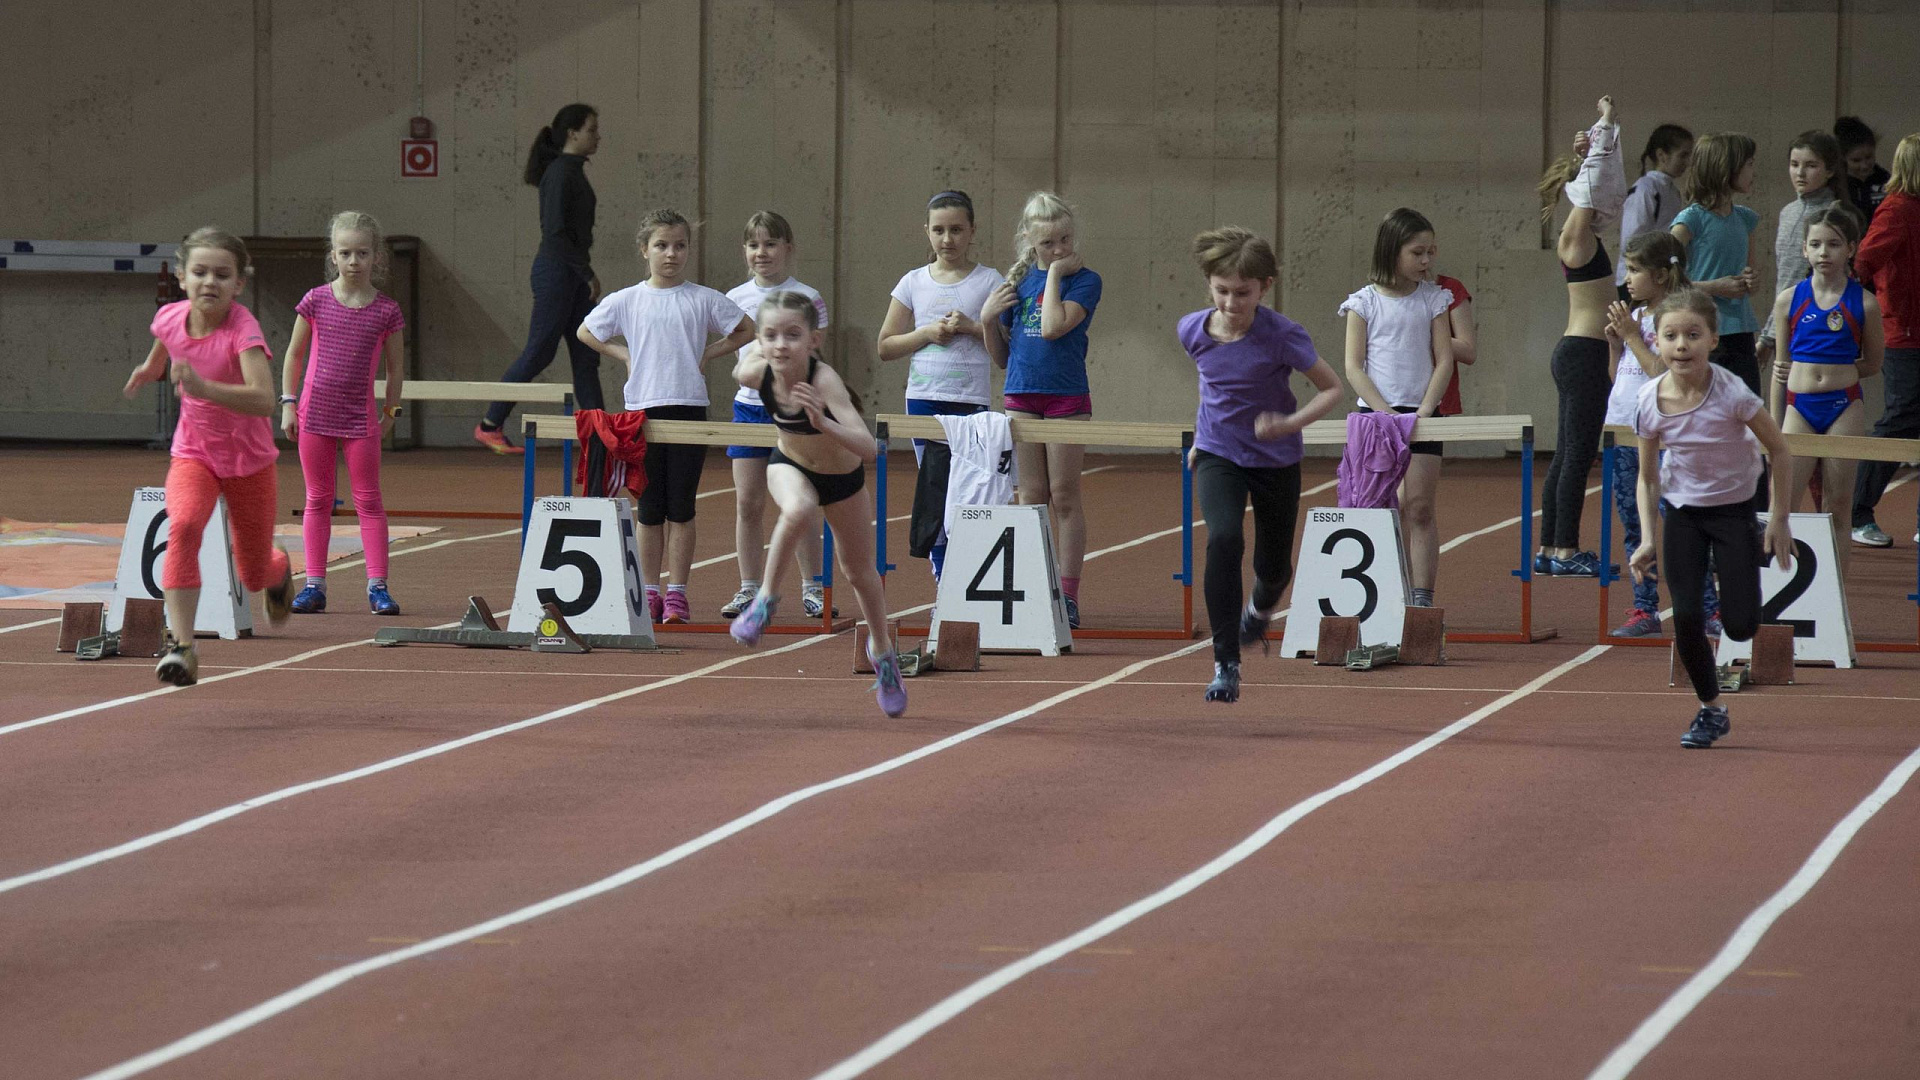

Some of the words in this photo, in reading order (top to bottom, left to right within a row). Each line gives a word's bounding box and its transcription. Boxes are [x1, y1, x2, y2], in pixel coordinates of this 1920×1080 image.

[141, 491, 166, 502] ESSO
[962, 509, 992, 520] ESSOR
[1313, 512, 1345, 522] ESSOR
[141, 508, 168, 599] 6
[537, 518, 602, 617] 5
[621, 518, 643, 617] 5
[966, 526, 1025, 625] 4
[1318, 528, 1378, 624] 3
[1758, 538, 1818, 638] 2
